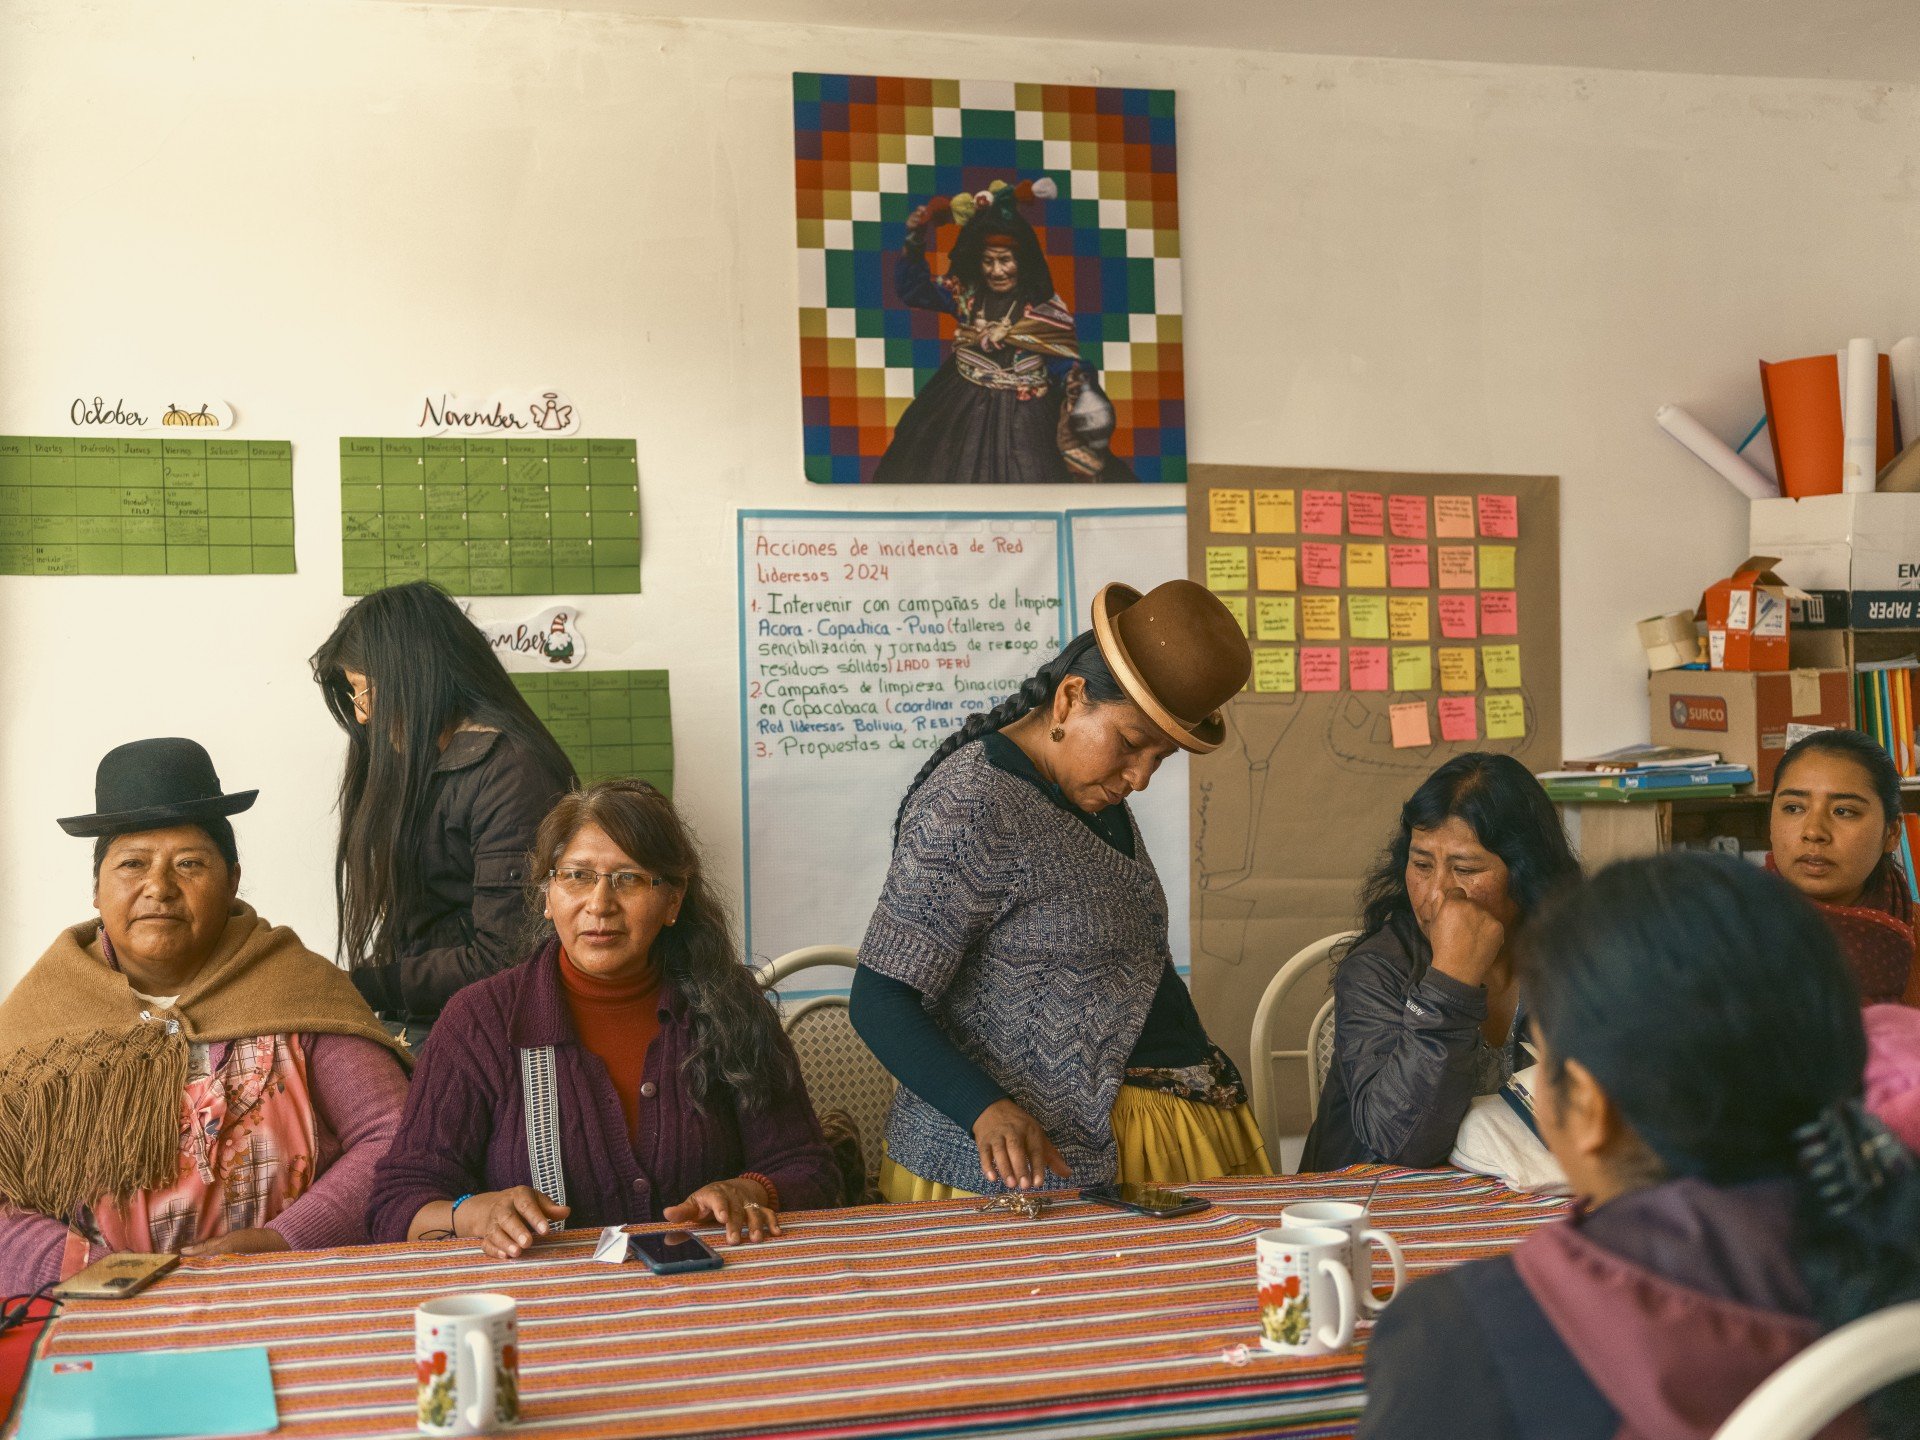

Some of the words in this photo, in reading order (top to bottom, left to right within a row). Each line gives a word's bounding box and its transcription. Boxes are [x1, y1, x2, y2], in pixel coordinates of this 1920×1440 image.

[71, 396, 148, 426] October
[418, 394, 528, 429] November
[756, 536, 837, 557] Acciones
[850, 537, 869, 557] de
[879, 538, 959, 557] incidencia
[970, 539, 985, 554] de
[992, 537, 1024, 554] Red
[843, 564, 890, 582] 2024
[767, 592, 852, 614] Intervenir
[863, 599, 890, 614] con
[898, 596, 979, 621] campañas
[988, 592, 1006, 609] de
[1868, 601, 1913, 620] PAPER
[758, 619, 803, 637] Acora
[1014, 618, 1032, 634] de
[874, 644, 882, 662] y
[967, 638, 982, 652] de
[760, 660, 829, 677] residuos
[896, 658, 930, 673] LADO
[937, 654, 971, 670] PERÚ
[764, 679, 848, 702] Campañas
[860, 681, 872, 693] de
[878, 678, 944, 700] limpieza
[760, 703, 776, 716] en
[960, 699, 984, 711] con
[1689, 707, 1725, 722] SURCO
[757, 718, 784, 735] Red
[777, 734, 880, 759] Propuestas
[888, 737, 906, 750] de
